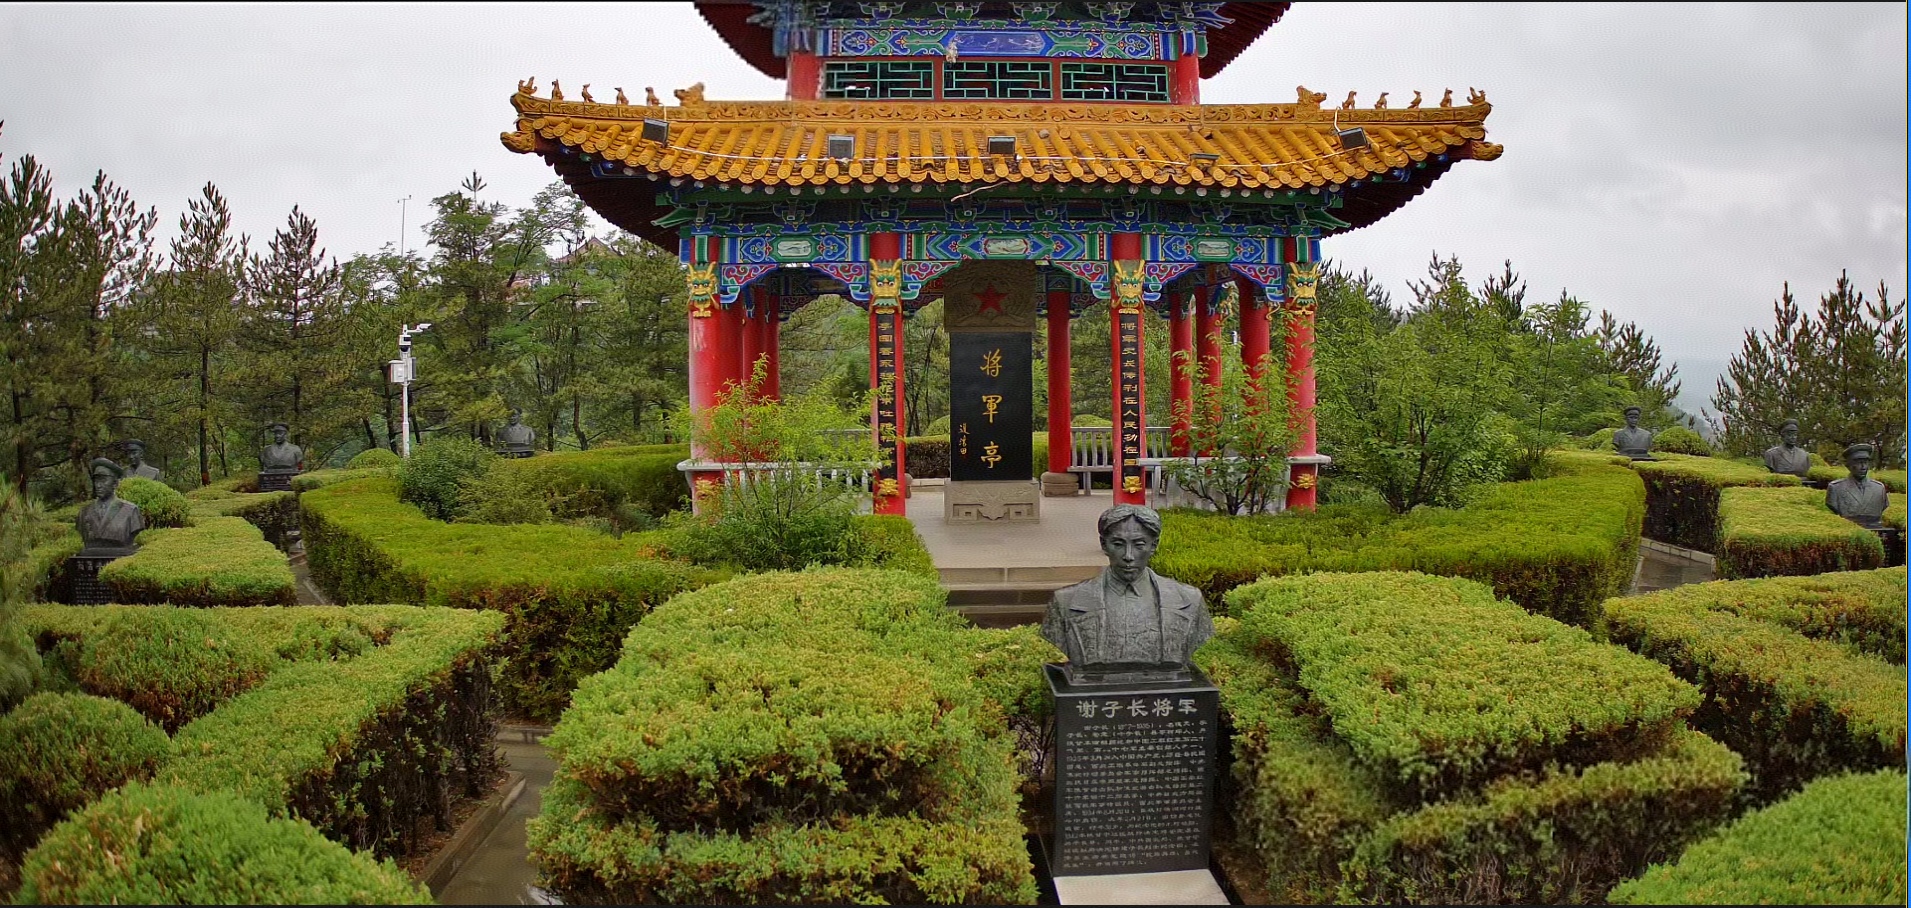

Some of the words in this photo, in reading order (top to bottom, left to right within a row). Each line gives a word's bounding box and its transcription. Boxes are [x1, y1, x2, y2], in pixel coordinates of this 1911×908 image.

[1076, 698, 1198, 719] 谢子长将军
